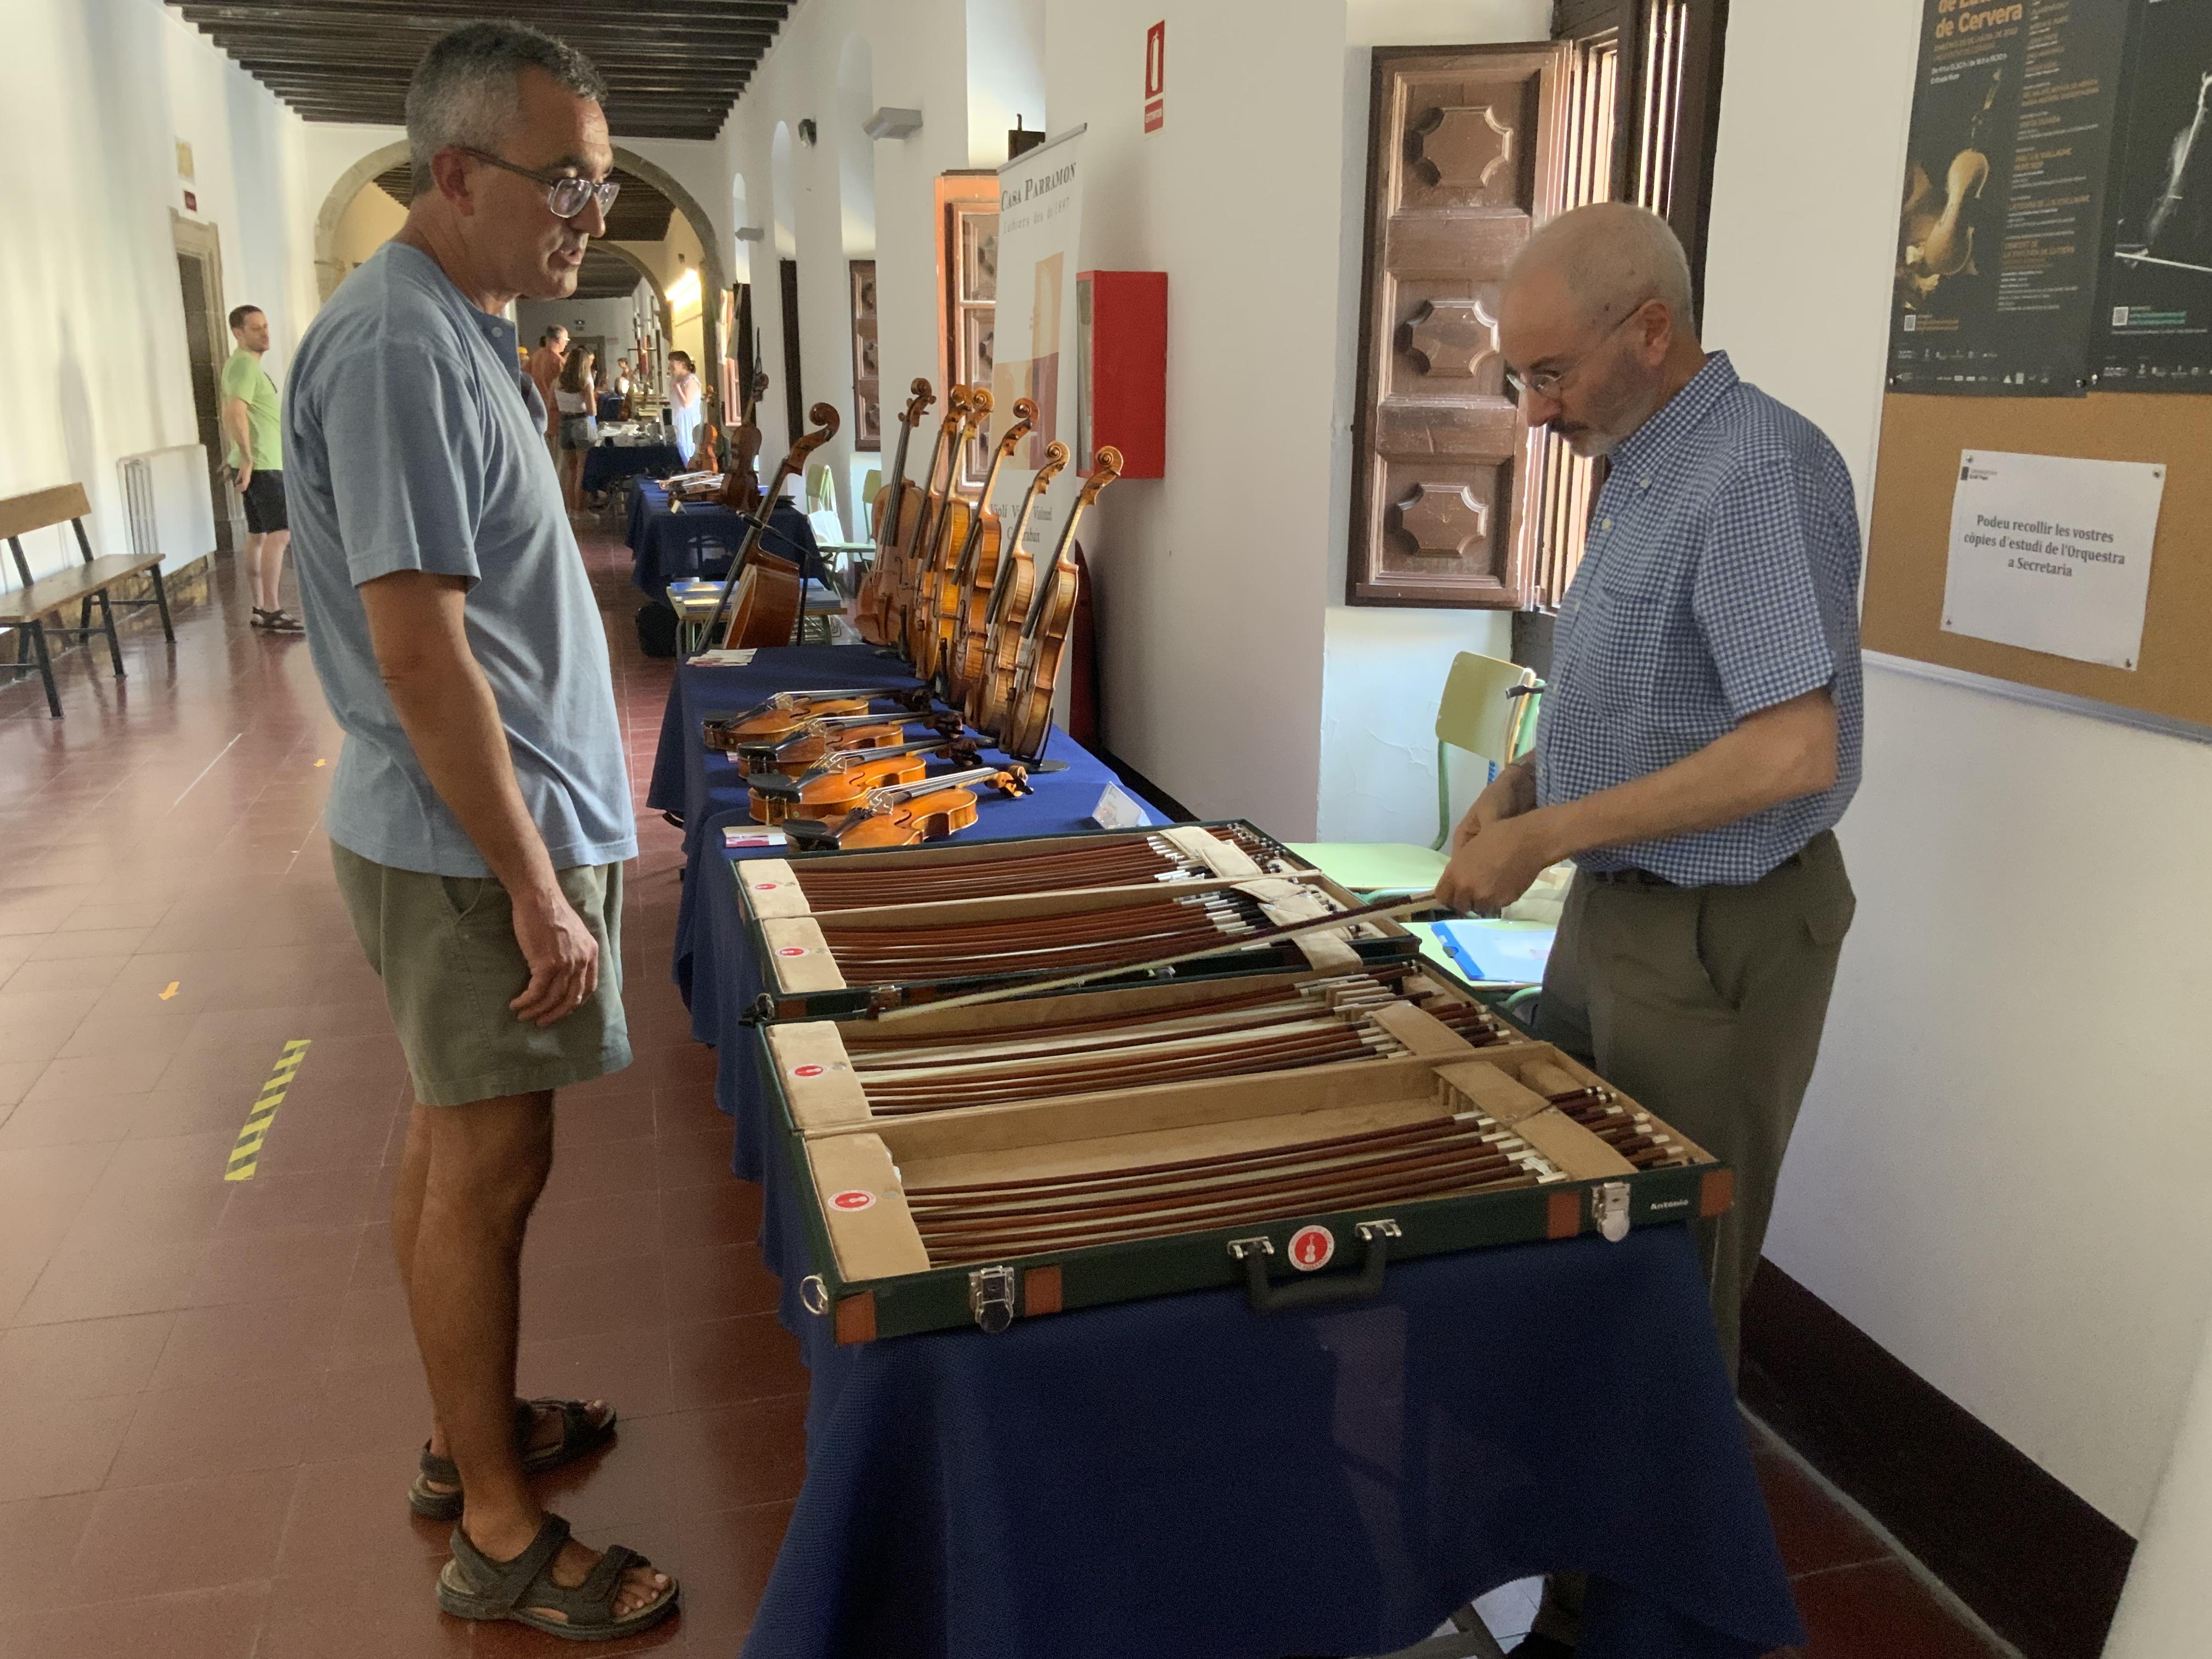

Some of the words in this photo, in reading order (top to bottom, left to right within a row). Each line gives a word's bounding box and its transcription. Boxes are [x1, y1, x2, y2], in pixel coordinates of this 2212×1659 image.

[1936, 18, 1954, 38] de
[1959, 3, 2022, 33] Cervera
[1977, 515, 2010, 529] Podeu
[2013, 521, 2053, 535] recollir
[2056, 524, 2070, 537] les
[2073, 528, 2114, 543] vostres
[1964, 532, 1996, 547] còpies
[2045, 542, 2058, 555] de
[2061, 544, 2125, 565] l'Orquestra
[2008, 558, 2014, 568] a
[2018, 557, 2073, 577] Secretaria
[1650, 1198, 1689, 1210] Antonio
